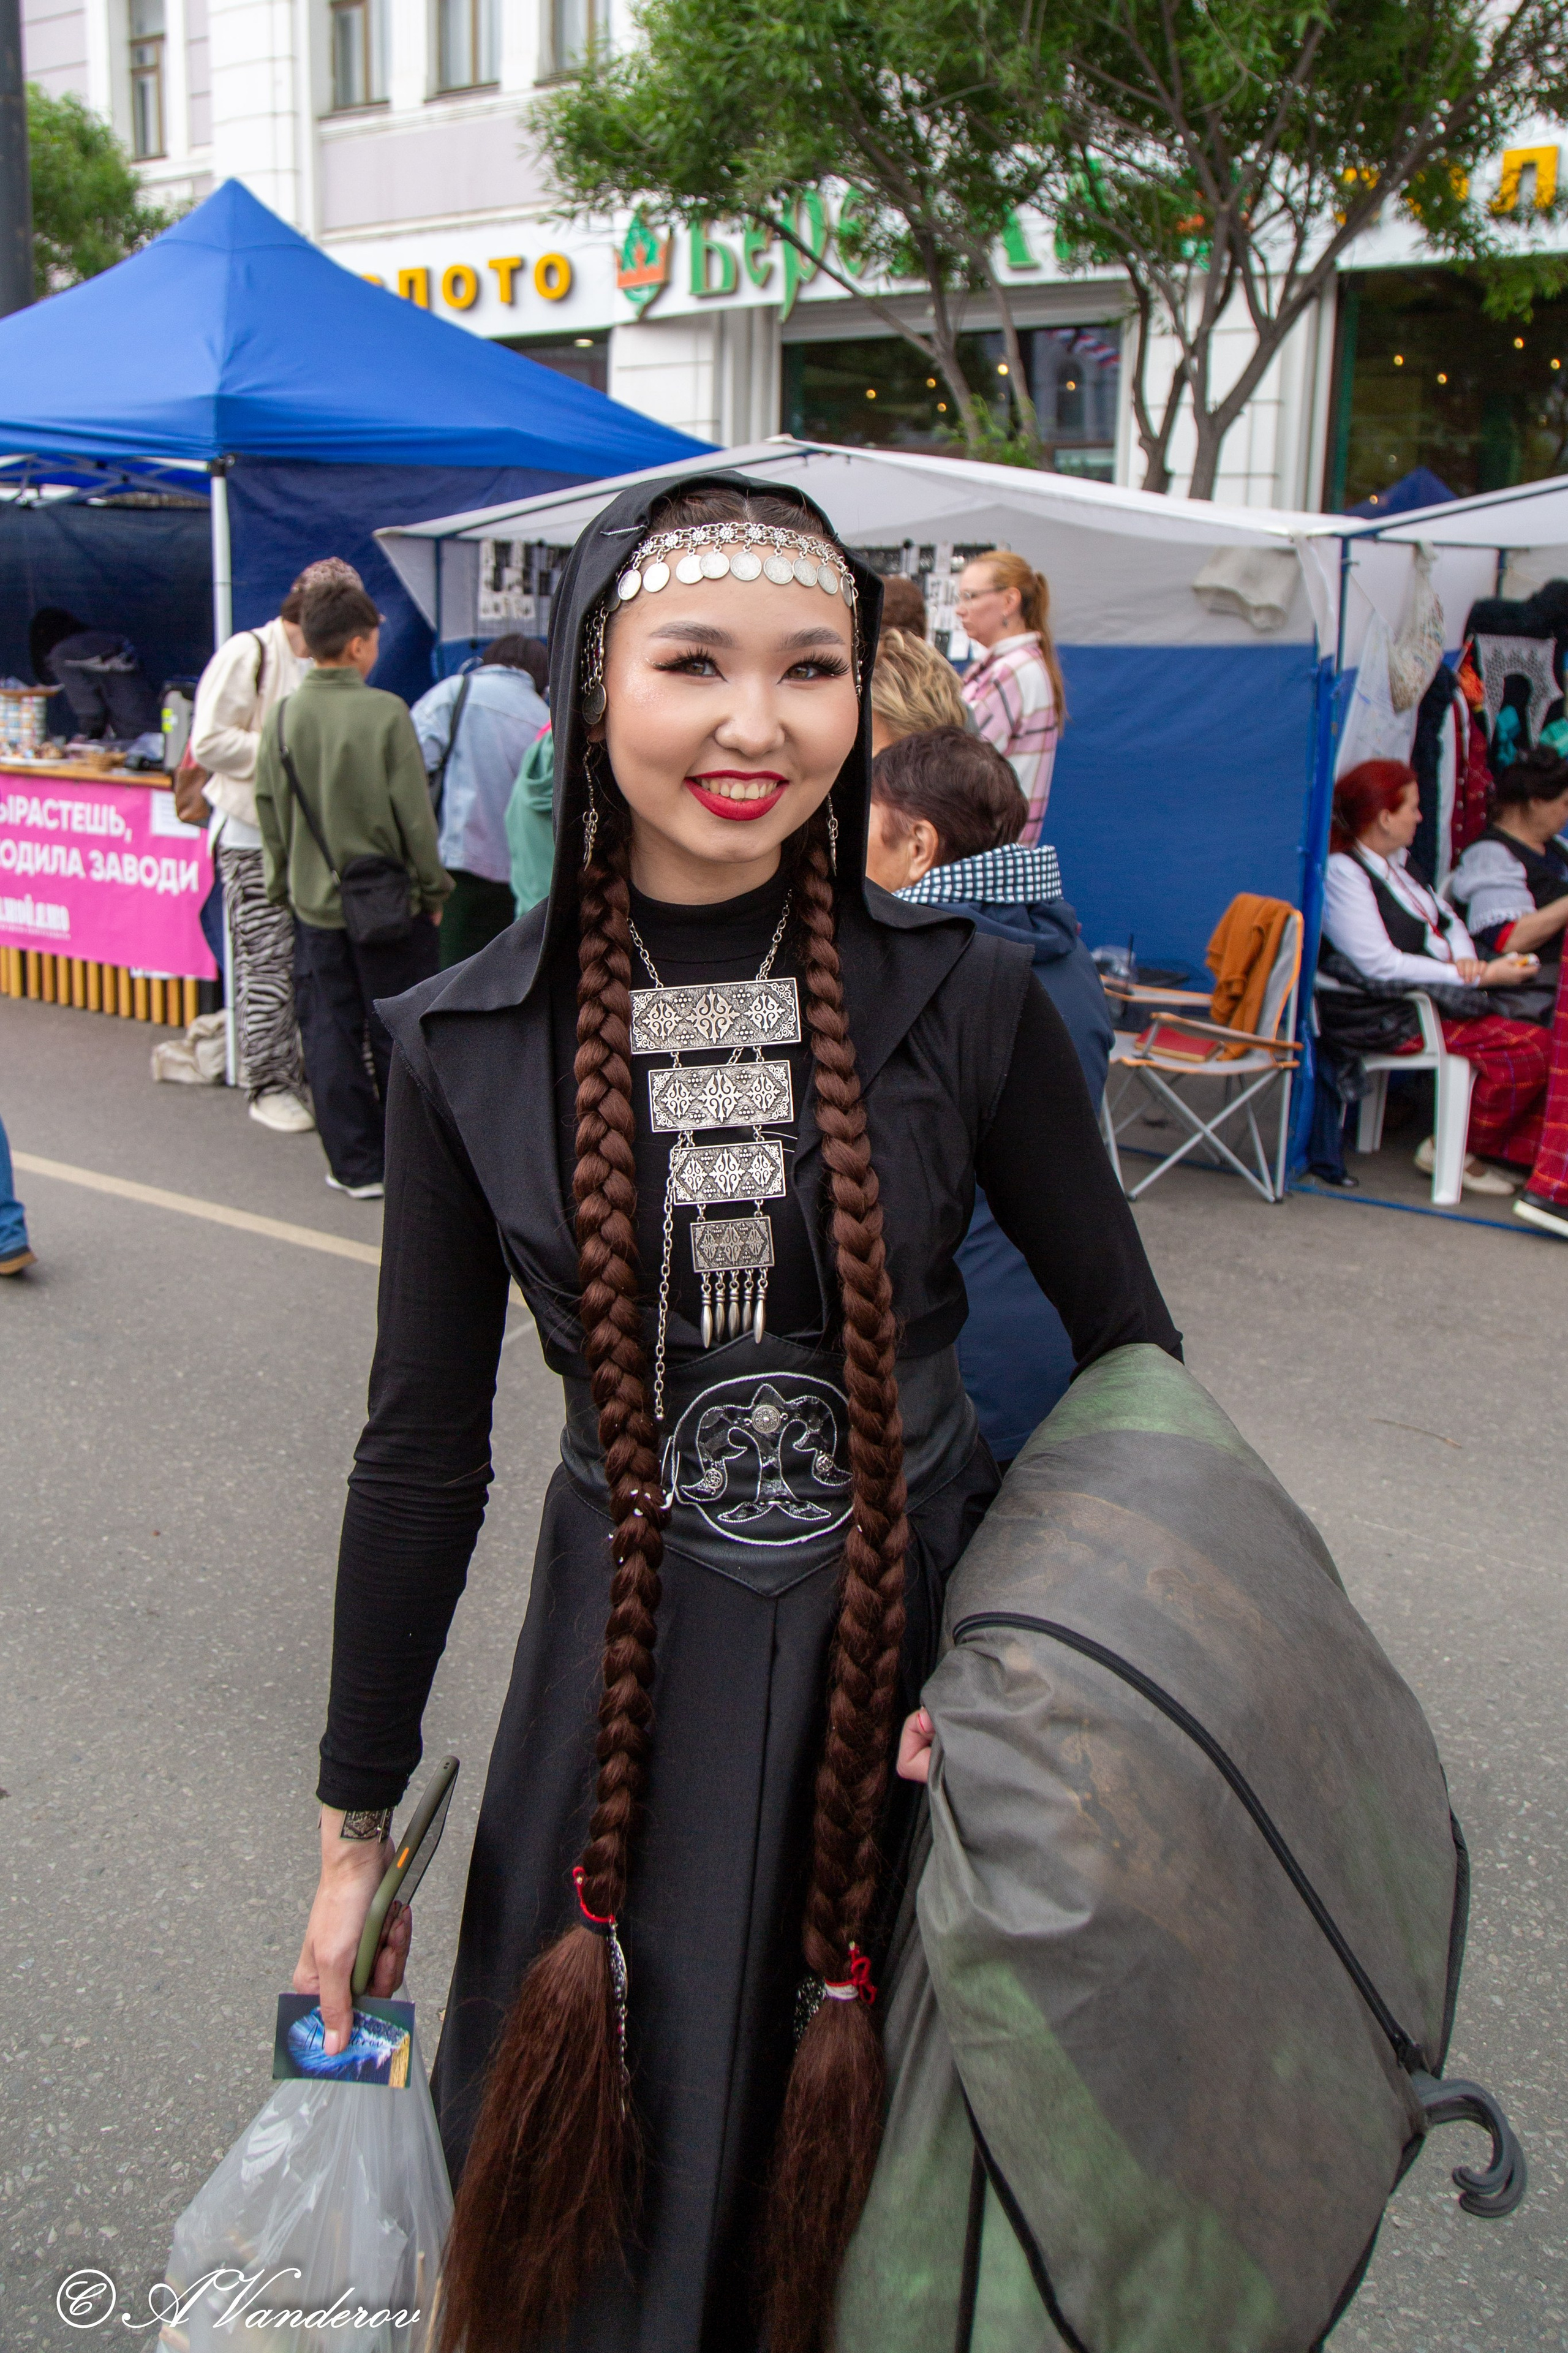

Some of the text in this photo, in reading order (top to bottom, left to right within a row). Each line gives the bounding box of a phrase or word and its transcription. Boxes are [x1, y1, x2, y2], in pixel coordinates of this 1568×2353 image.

[360, 253, 571, 309] ЛОТО
[0, 838, 200, 896] ОДИЛА ЗАВОДИ
